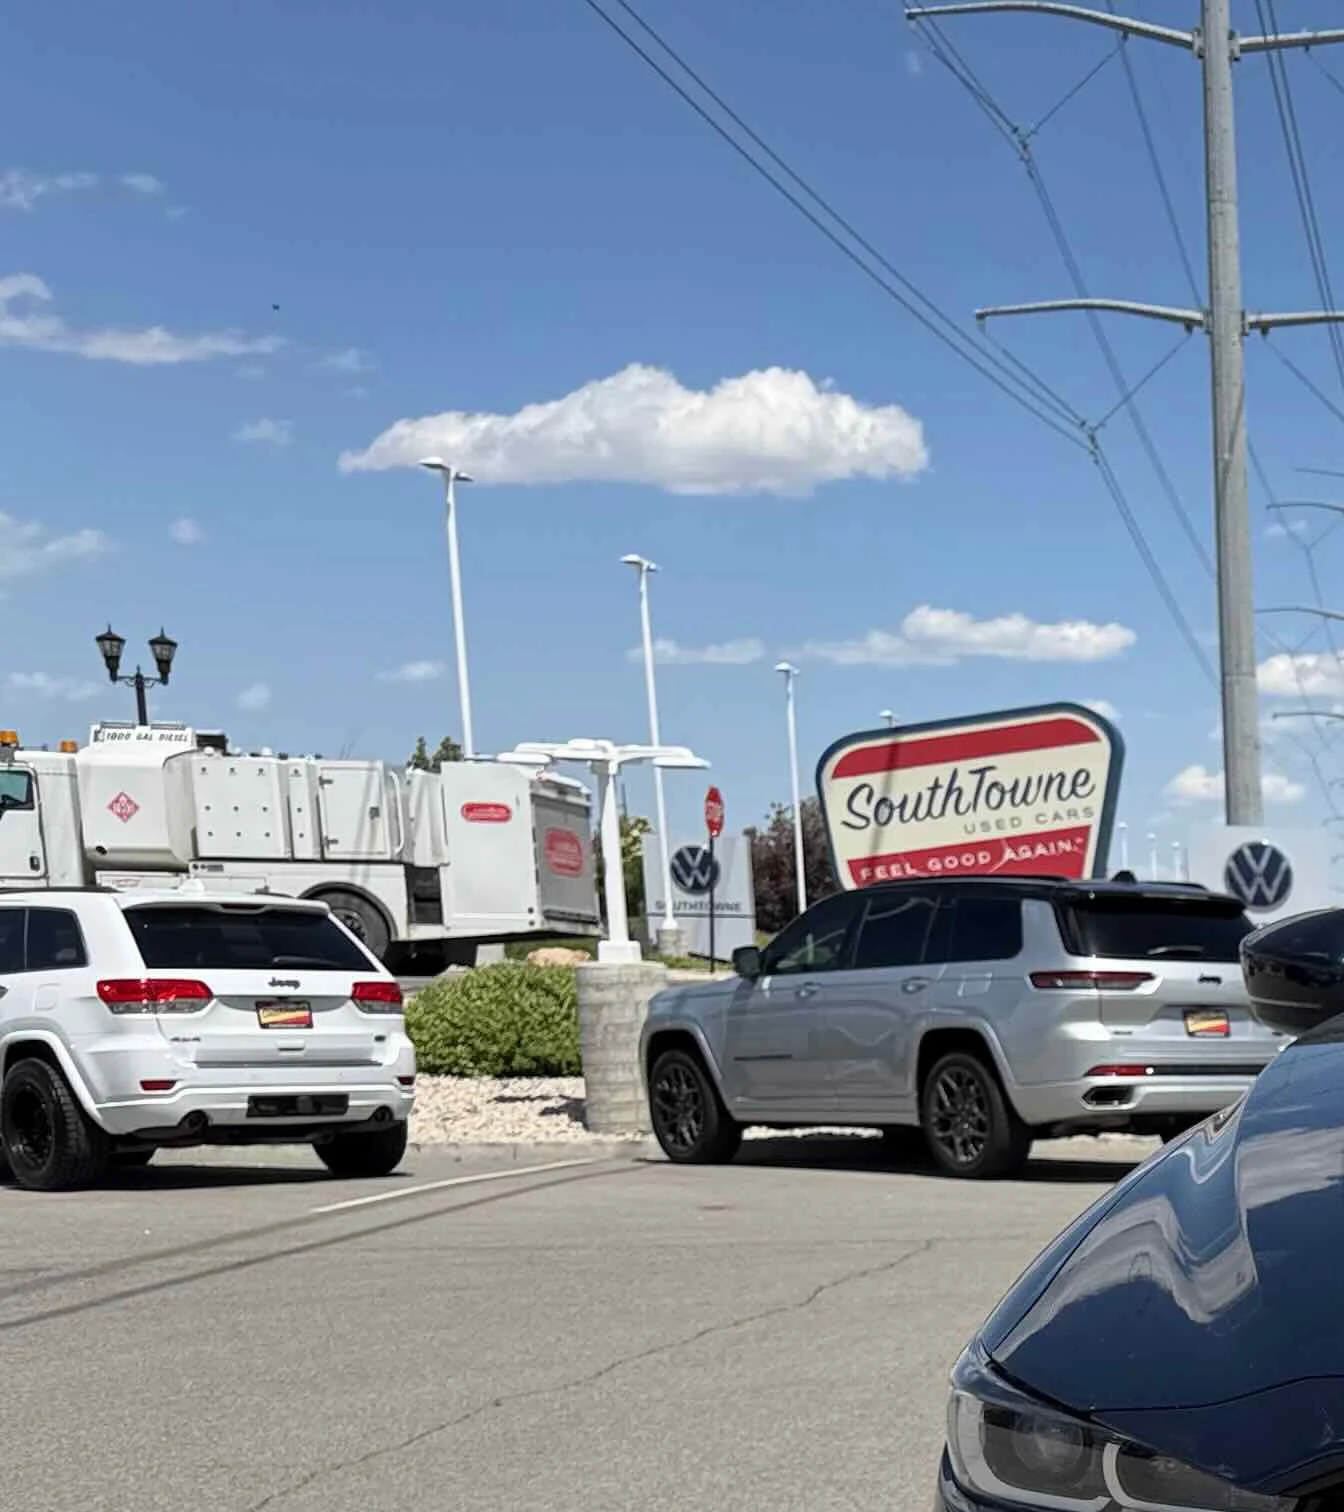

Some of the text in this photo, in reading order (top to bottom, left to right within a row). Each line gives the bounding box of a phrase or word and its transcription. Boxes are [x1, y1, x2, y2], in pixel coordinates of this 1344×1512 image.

[841, 765, 1096, 830] SouthTowne
[963, 806, 1095, 835] USED CARS
[860, 863, 919, 881] FEEL
[927, 852, 992, 872] GOOD
